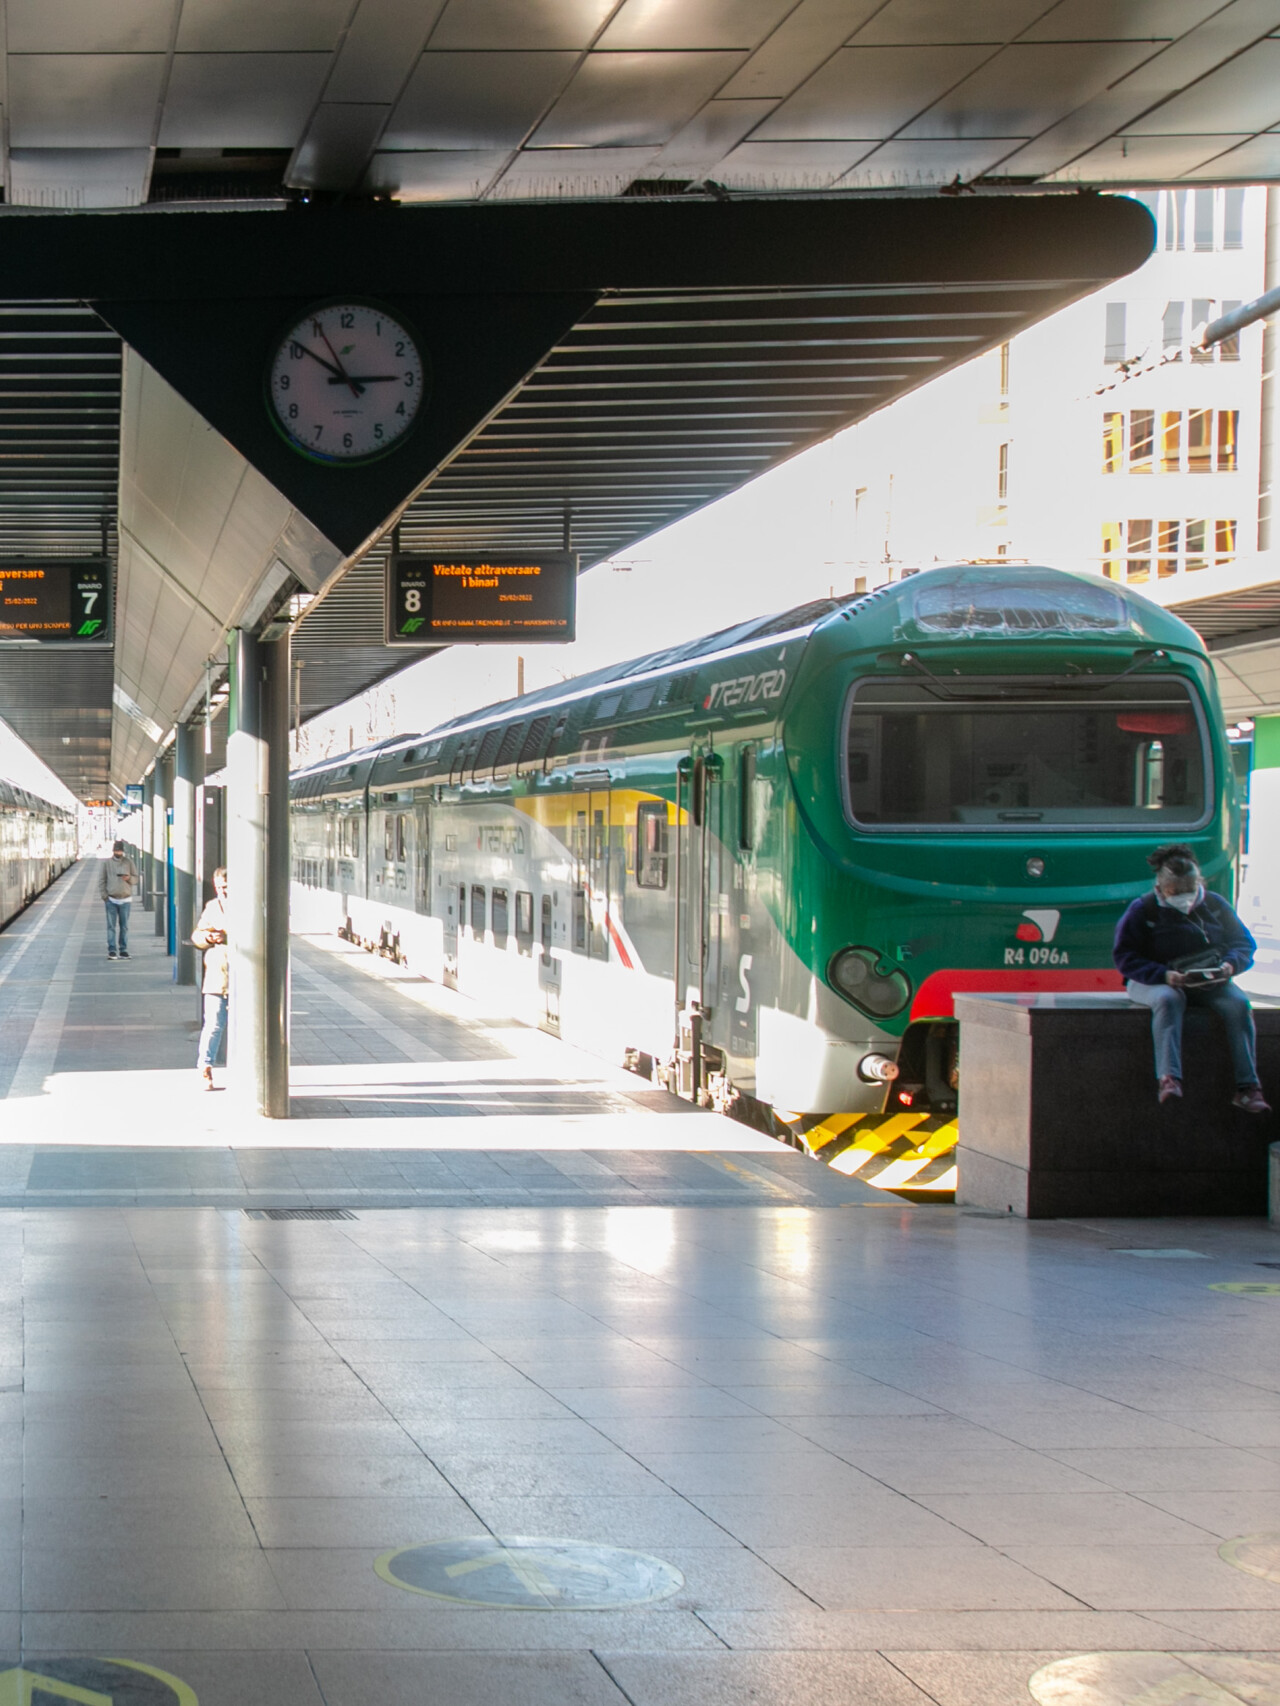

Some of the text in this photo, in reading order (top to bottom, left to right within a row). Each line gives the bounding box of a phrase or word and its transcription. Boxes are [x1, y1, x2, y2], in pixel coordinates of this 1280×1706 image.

[341, 313, 355, 329] 12
[395, 342, 405, 357] 2
[280, 375, 290, 390] 9
[404, 371, 414, 387] 3
[289, 403, 299, 419] 8
[395, 401, 406, 416] 4
[314, 425, 323, 441] 7
[374, 424, 384, 439] 5
[343, 433, 353, 448] 6
[433, 564, 542, 576] Vietato attraversare
[462, 576, 499, 588] i binari
[4, 597, 38, 605] 25/02/2022
[81, 592, 99, 615] 7
[404, 589, 421, 612] 8
[499, 594, 533, 602] 25/02/2022
[708, 668, 786, 709] TRENORD
[478, 825, 525, 855] TRENORD
[1004, 947, 1069, 965] R4 096A
